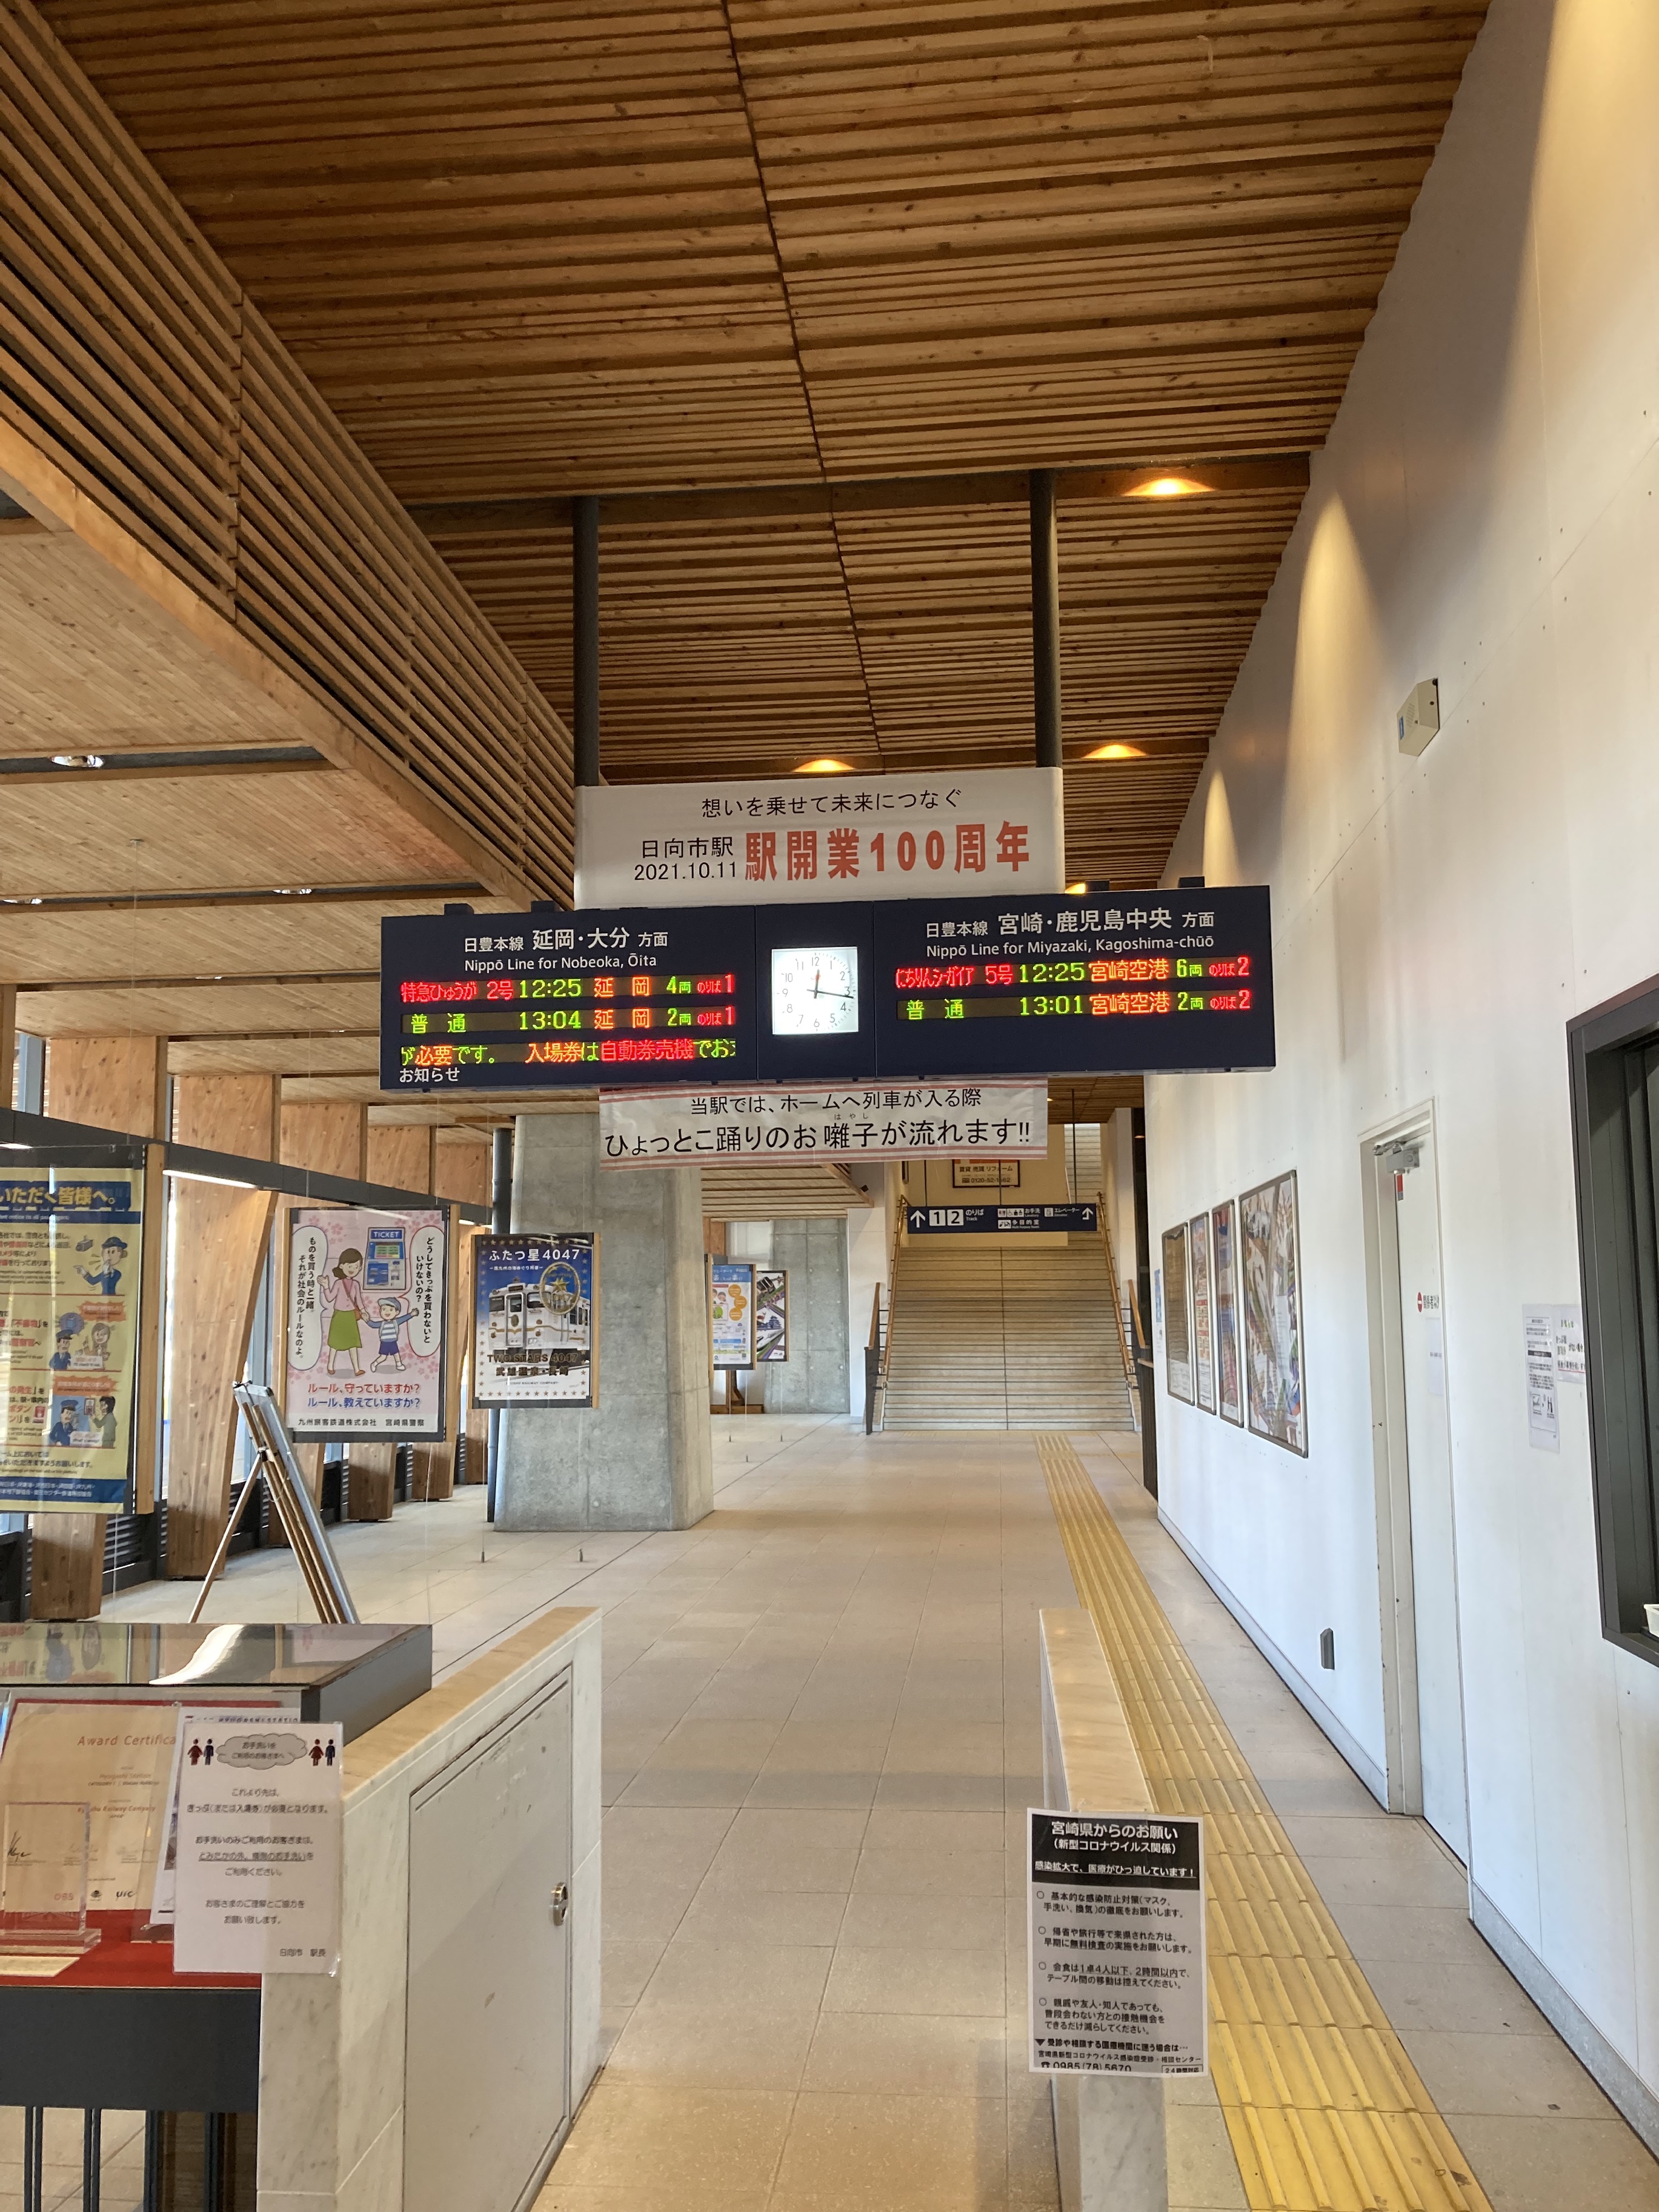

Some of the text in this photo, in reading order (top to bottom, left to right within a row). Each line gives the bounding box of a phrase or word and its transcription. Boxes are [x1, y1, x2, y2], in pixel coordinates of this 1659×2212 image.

[702, 788, 962, 818] 想いを乗せて未来につなぐ
[641, 837, 734, 859] 日向市駅
[745, 820, 1030, 882] 駅開業100周年
[634, 863, 737, 882] 2021.10.11
[926, 907, 1215, 938] 日豊本線 宮崎・鹿児島中央 方面
[465, 927, 668, 952] 日豊本線 延岡・大分 方面
[926, 936, 1214, 959] Nippō Line for Miyazaki, Kagoshima-chūō
[465, 953, 657, 974] Nippō Line for Nobeoka, Ōita
[797, 961, 804, 971] 11
[811, 956, 819, 966] 12
[785, 972, 793, 983] 10
[840, 971, 845, 981] 2
[985, 964, 1013, 985] 5号
[1019, 962, 1085, 983] 12:25
[1088, 958, 1169, 982] 宮崎空港
[1176, 958, 1203, 977] 6両
[401, 981, 478, 1002] 特急ひゅうが
[487, 980, 514, 1000] 2号
[519, 978, 582, 998] 12:25
[667, 975, 691, 994] 4両
[782, 988, 788, 997] 9
[786, 1003, 793, 1013] 8
[840, 1001, 846, 1011] 4
[1020, 995, 1083, 1017] 13:01
[1089, 991, 1170, 1016] 宮崎空港
[1177, 992, 1203, 1011] 2両
[519, 1011, 582, 1030] 13:04
[667, 1008, 691, 1026] 2両
[799, 1014, 803, 1024] 7
[814, 1018, 820, 1028] 6
[830, 1013, 835, 1023] 5
[399, 1067, 460, 1084] お知らせ
[690, 1089, 982, 1116] 当駅では、ホームへ列車が入る際
[834, 1112, 869, 1120] はやし
[487, 1352, 579, 1363] TWO STARS 4047
[307, 1383, 420, 1394] ルール、守っていますか？
[307, 1397, 421, 1409] ルール、教えていますか？
[77, 1735, 119, 1746] Award
[1051, 1821, 1179, 1839] 宮崎県からのお願い
